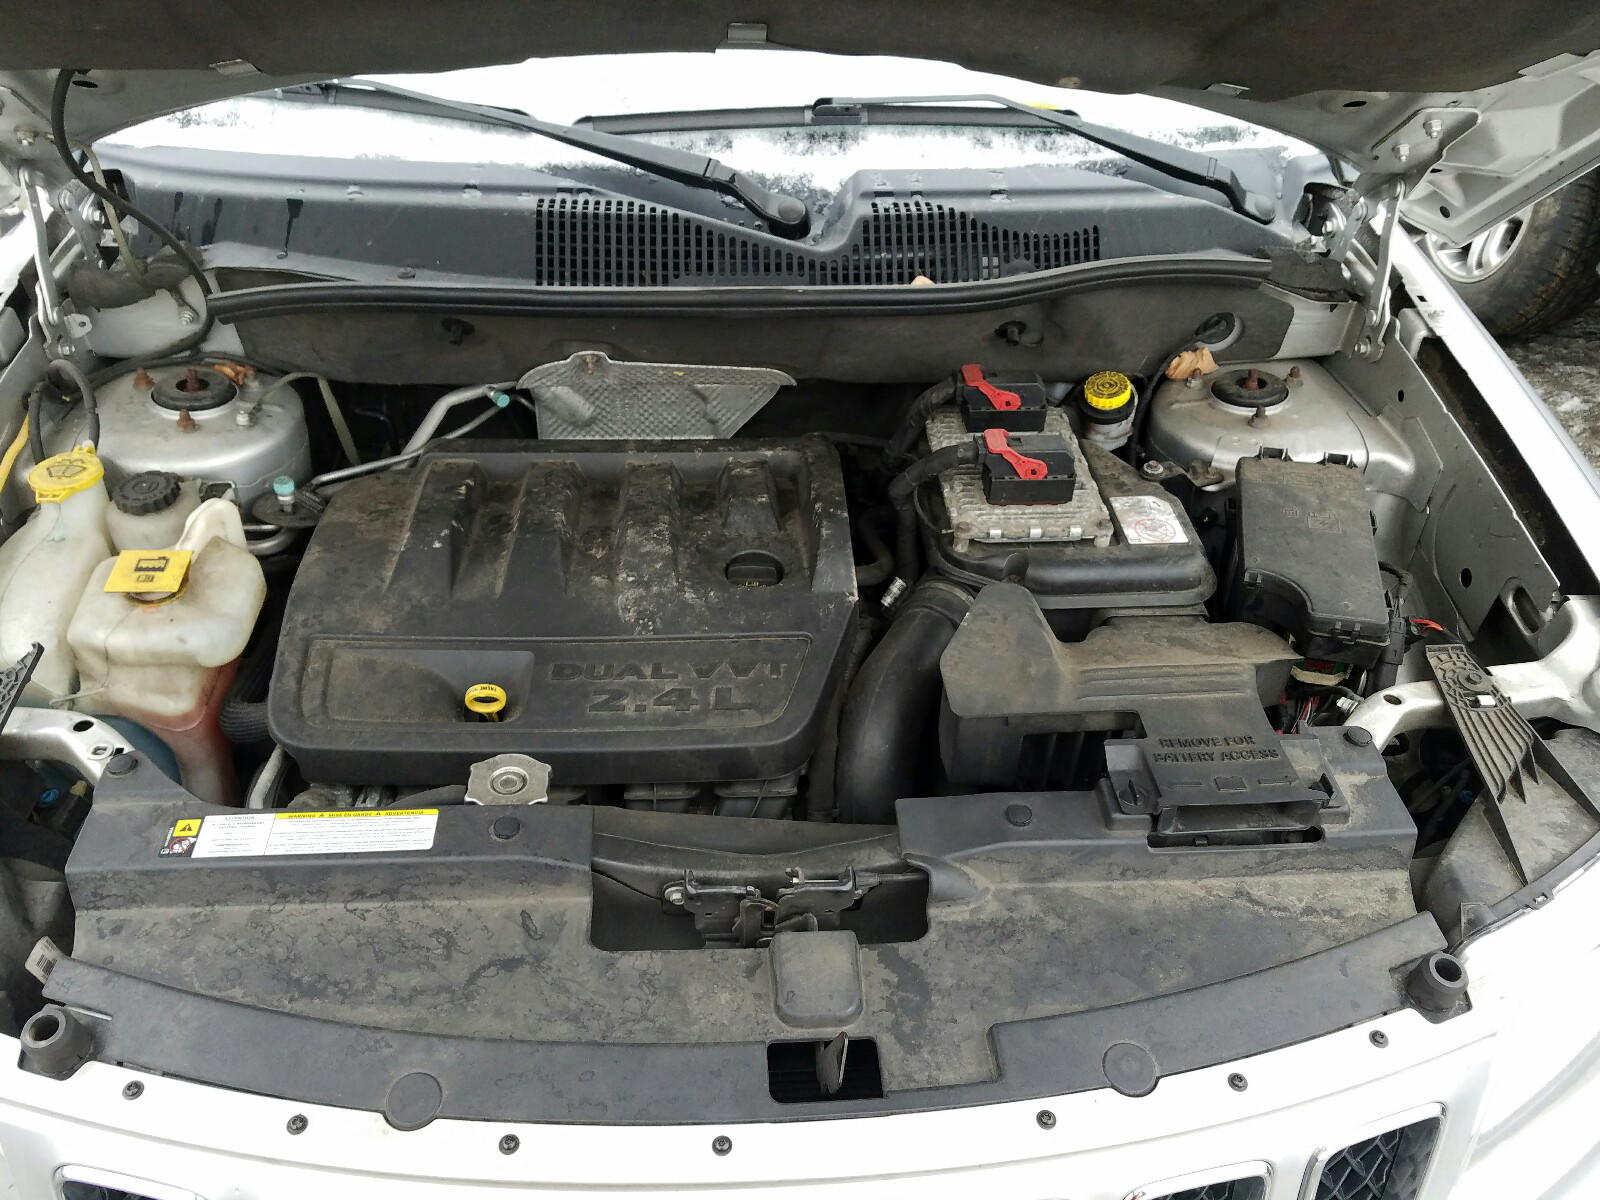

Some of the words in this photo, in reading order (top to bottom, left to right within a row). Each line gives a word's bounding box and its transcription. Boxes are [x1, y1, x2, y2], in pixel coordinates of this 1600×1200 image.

[549, 662, 679, 681] DUAL
[688, 662, 788, 680] VVT
[587, 686, 754, 713] 2.4L
[1158, 736, 1221, 748] REMOVE
[1222, 735, 1256, 746] FOR
[1152, 751, 1216, 763] BATTERY
[1221, 748, 1280, 762] ACCESS
